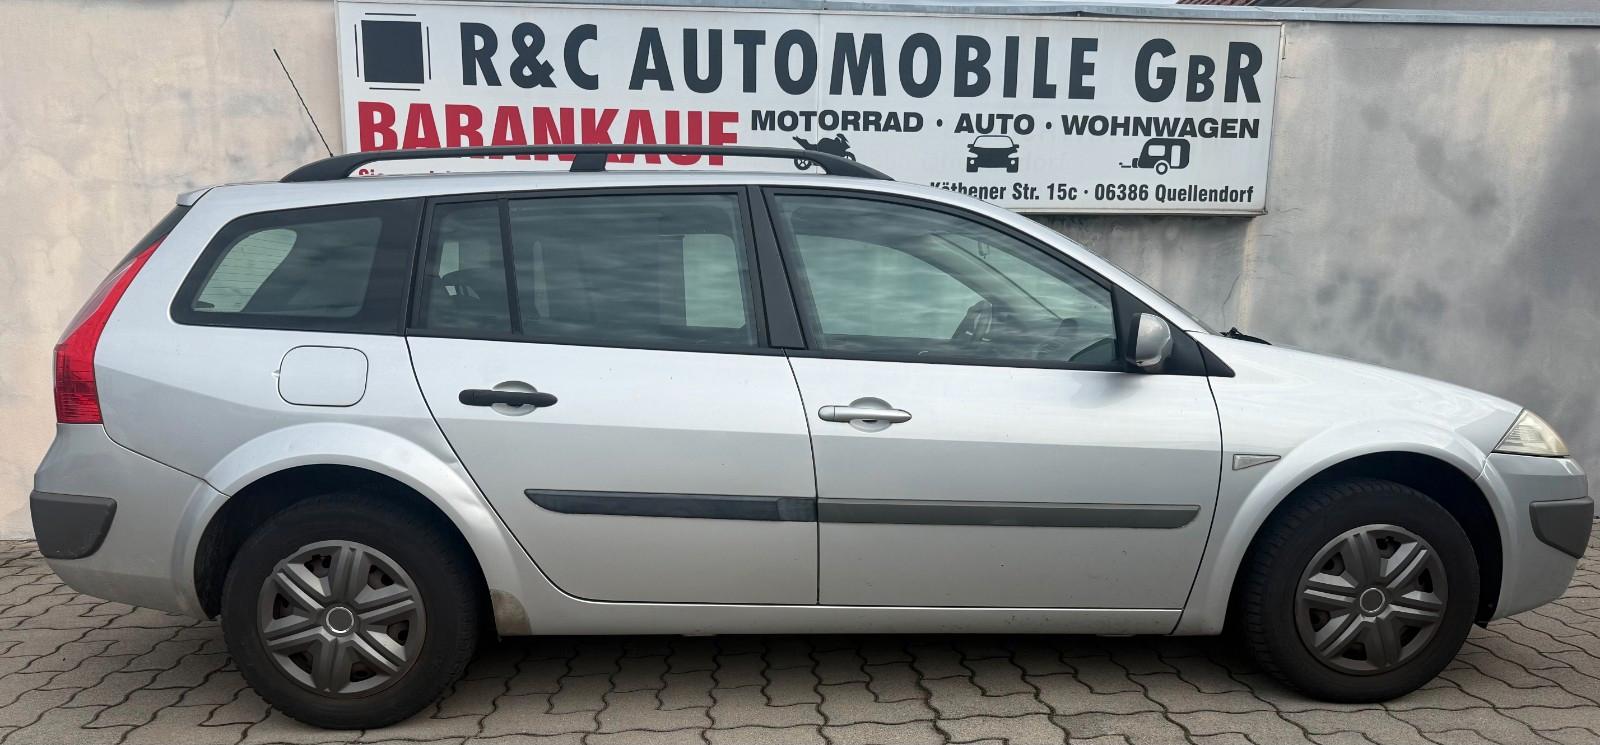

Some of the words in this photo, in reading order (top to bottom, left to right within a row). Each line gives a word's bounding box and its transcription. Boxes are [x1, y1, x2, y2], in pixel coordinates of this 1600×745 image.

[459, 21, 599, 91] R&C
[628, 27, 1099, 100] AUTOMOBILE
[358, 101, 739, 166] BARANKAUF
[751, 109, 924, 133] MOTORRAD
[953, 112, 1035, 135] AUTO
[1060, 114, 1260, 139] WOHNWAGEN
[1011, 182, 1040, 201] Str.
[1046, 182, 1078, 201] 15c
[1094, 183, 1149, 201] 06386
[1155, 183, 1254, 204] Quellendorf
